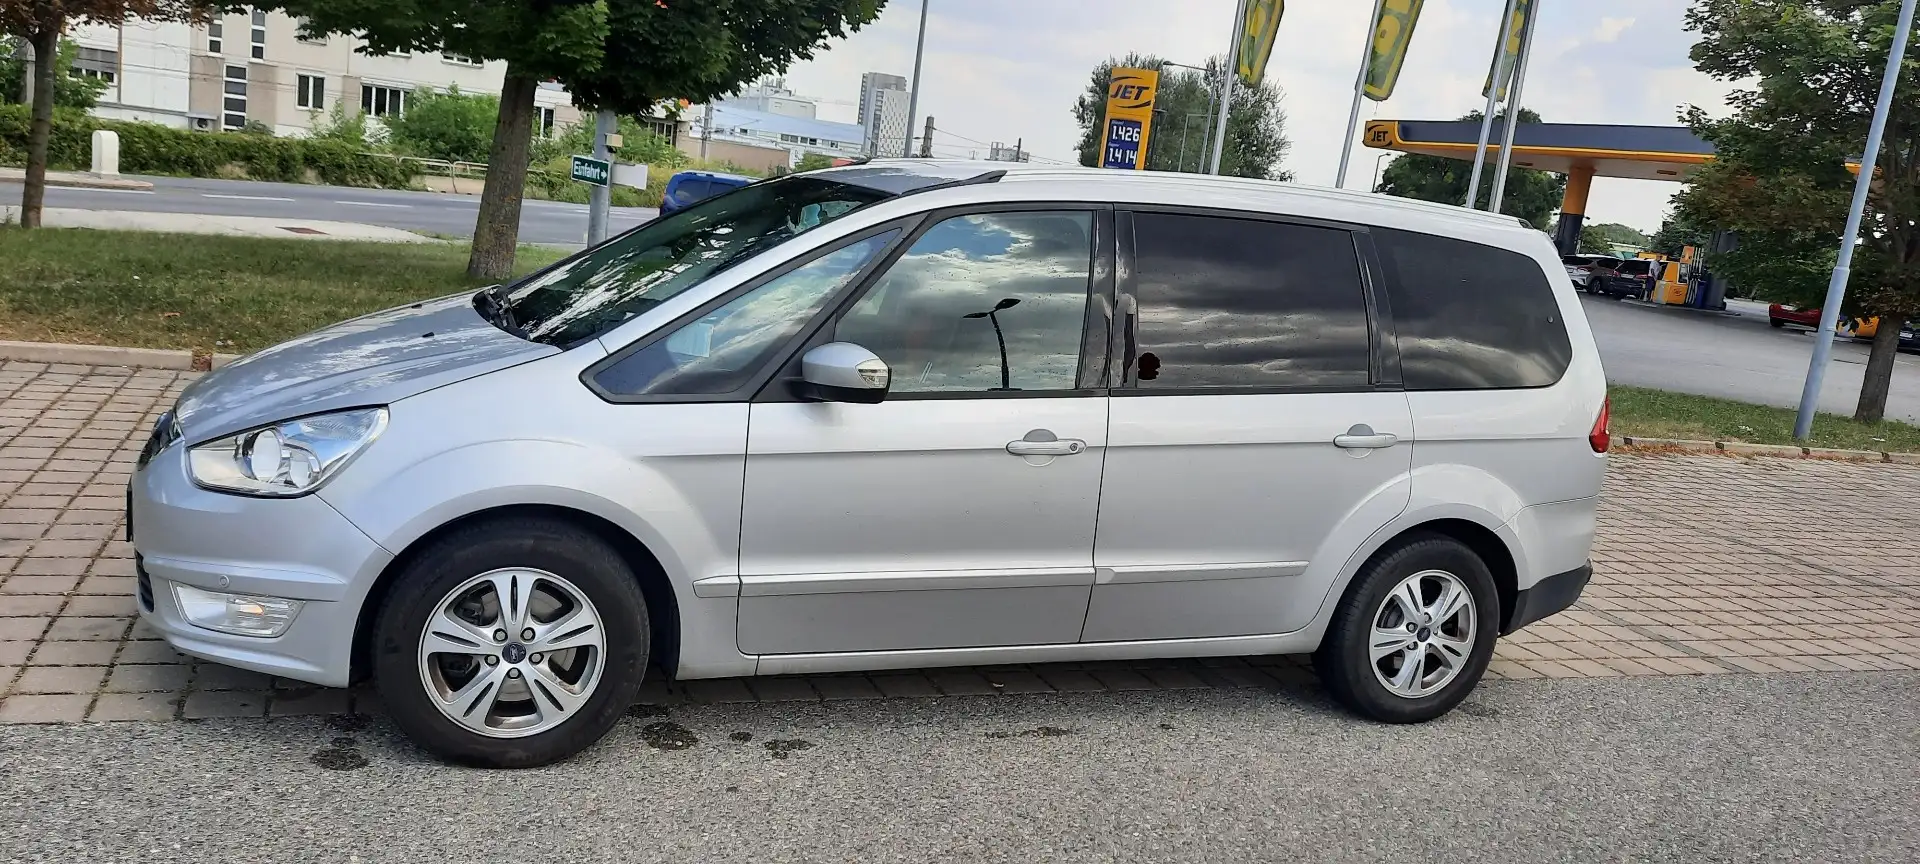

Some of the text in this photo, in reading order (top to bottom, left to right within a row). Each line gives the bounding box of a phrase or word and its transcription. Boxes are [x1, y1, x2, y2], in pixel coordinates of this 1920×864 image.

[1110, 84, 1150, 100] JET
[1112, 126, 1140, 142] 1.426
[1371, 131, 1388, 142] JET
[574, 160, 600, 180] Einfahrt
